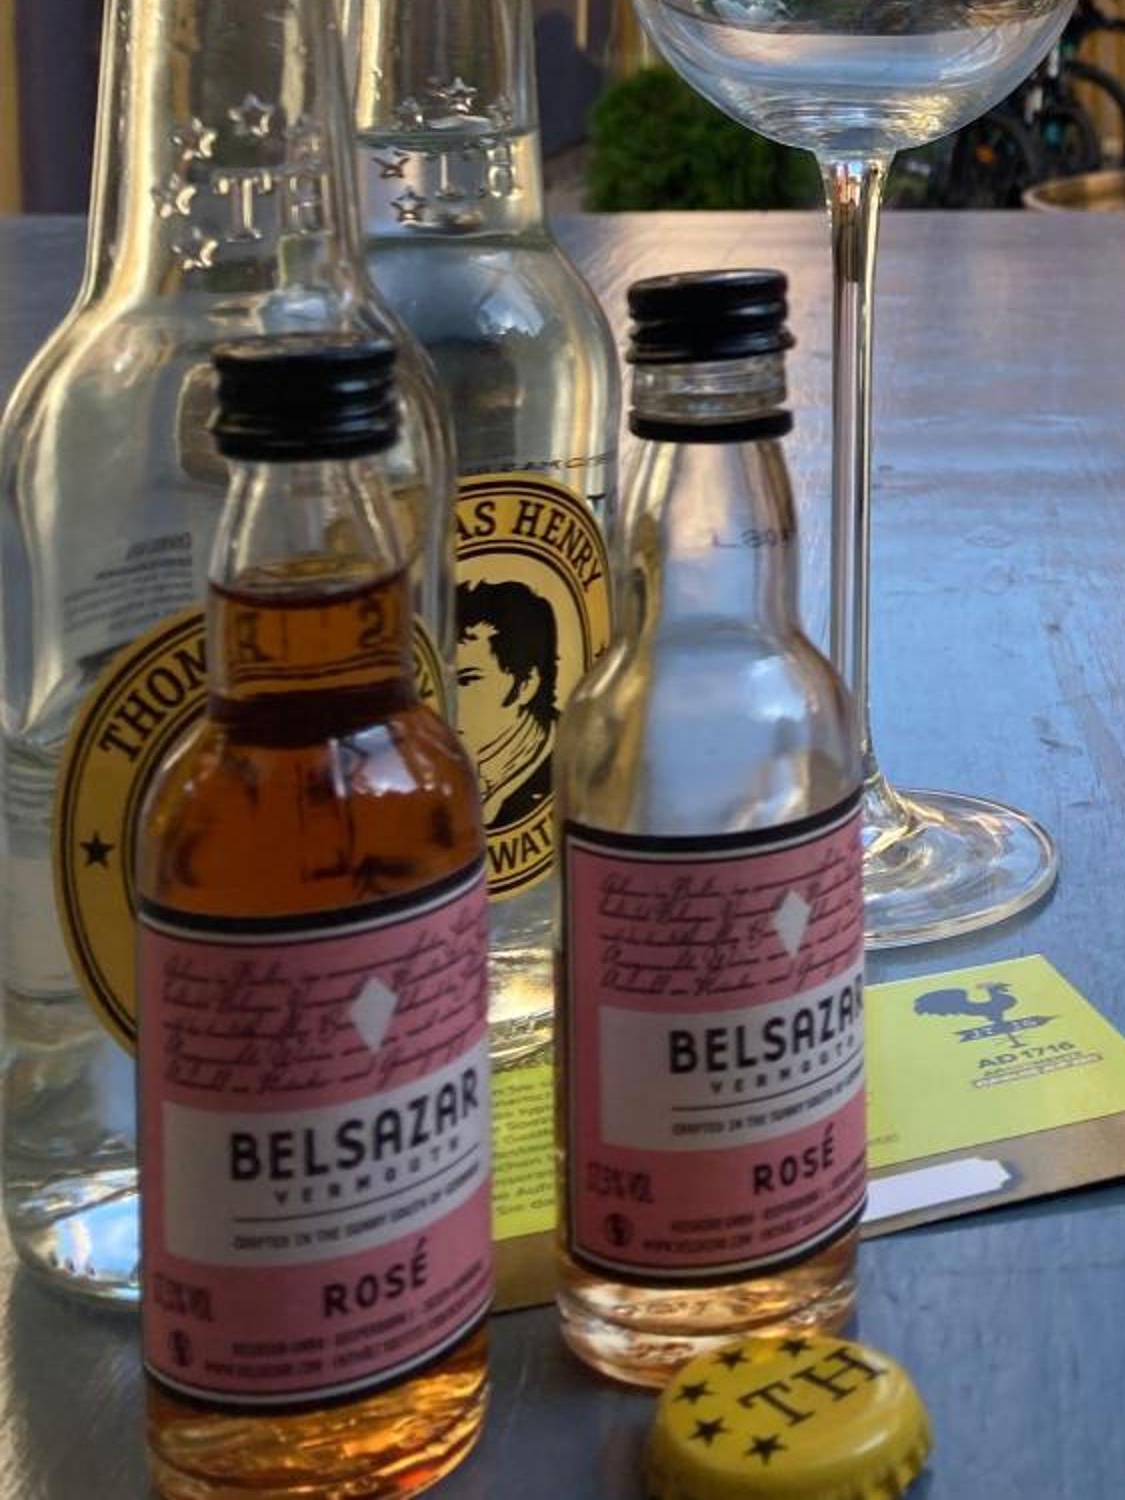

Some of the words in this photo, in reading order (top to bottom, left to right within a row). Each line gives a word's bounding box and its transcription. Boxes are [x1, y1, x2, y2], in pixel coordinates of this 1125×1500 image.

[512, 500, 603, 593] HENRY
[488, 812, 554, 876] WAT
[978, 1053, 1017, 1069] AD
[1020, 1041, 1076, 1060] 1716
[230, 1067, 479, 1181] BELSAZAR
[753, 1122, 835, 1196] ROSÉ
[322, 1237, 429, 1318] ROSÉ
[736, 1347, 889, 1428] TH
